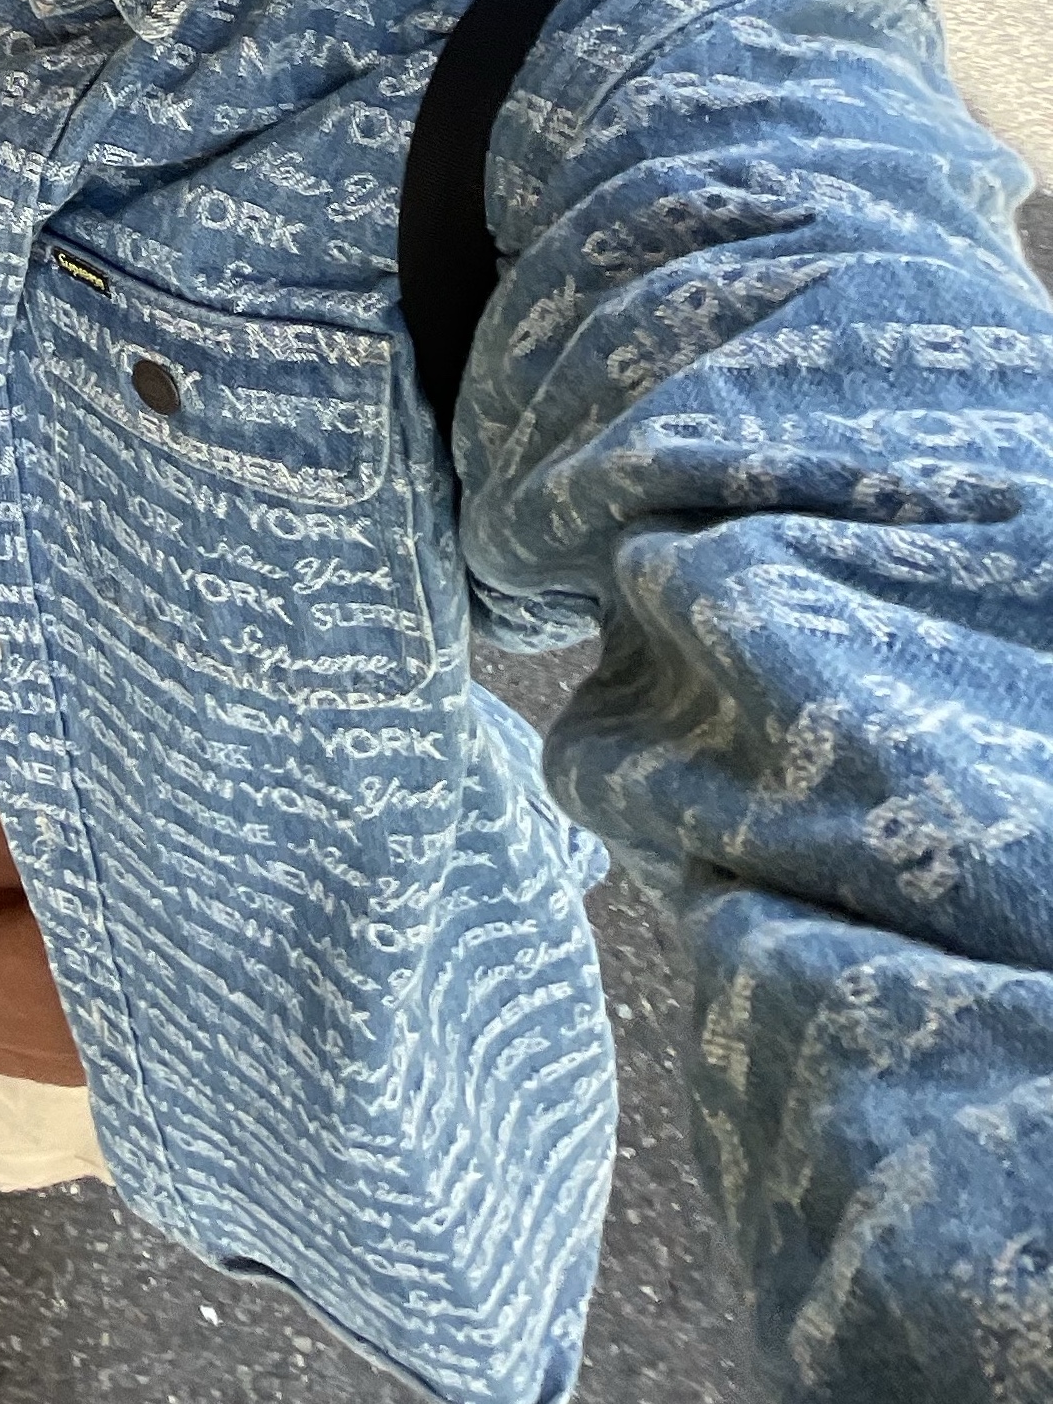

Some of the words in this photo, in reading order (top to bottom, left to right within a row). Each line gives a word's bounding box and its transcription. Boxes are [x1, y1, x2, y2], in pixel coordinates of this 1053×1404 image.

[176, 183, 307, 256] YORK
[141, 448, 230, 520] NEW
[234, 495, 377, 550] YORK
[168, 556, 295, 626] YORK
[294, 556, 401, 595] York
[220, 624, 398, 674] Supreme
[205, 693, 304, 746] NEW
[309, 726, 449, 761] YORK
[149, 731, 235, 802] NEW
[239, 780, 363, 846] YORK
[353, 776, 453, 820] York
[245, 853, 335, 917] NEW
